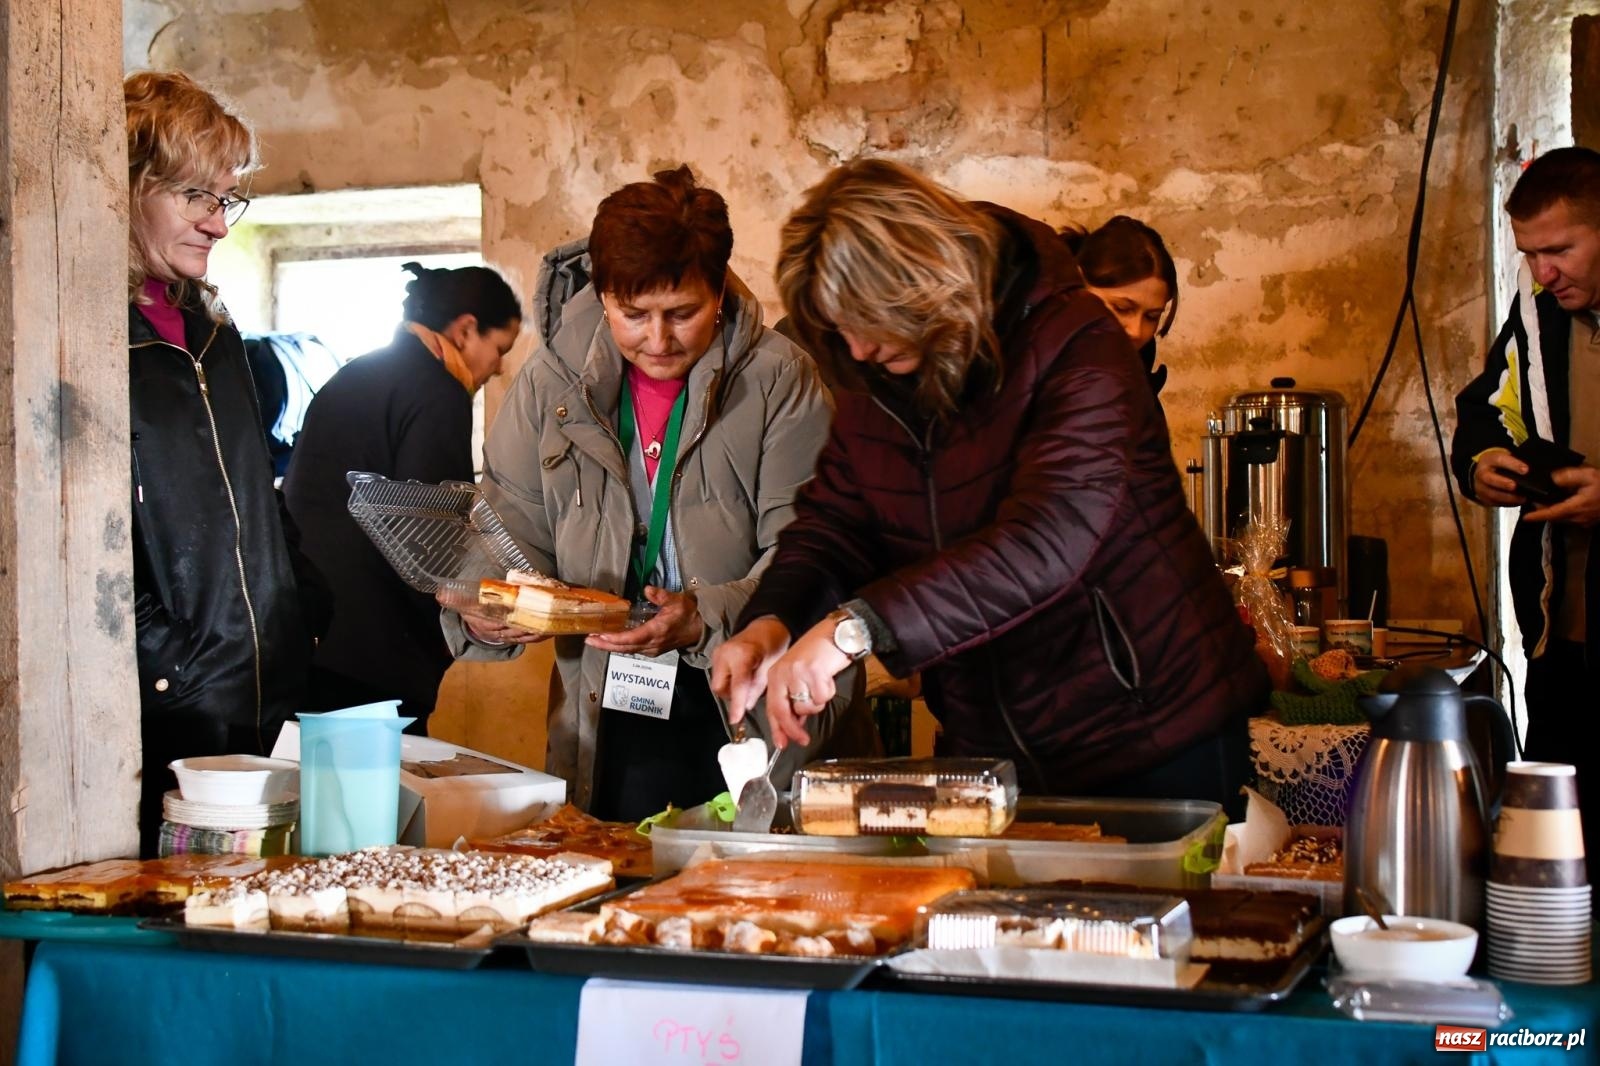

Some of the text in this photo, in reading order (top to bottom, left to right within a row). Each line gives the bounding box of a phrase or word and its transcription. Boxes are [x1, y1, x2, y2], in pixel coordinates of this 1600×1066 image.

[611, 670, 670, 690] WYSTAWCA
[630, 695, 655, 706] GMINA
[629, 703, 663, 715] RUDNIK
[653, 1012, 741, 1060] PTYŚ
